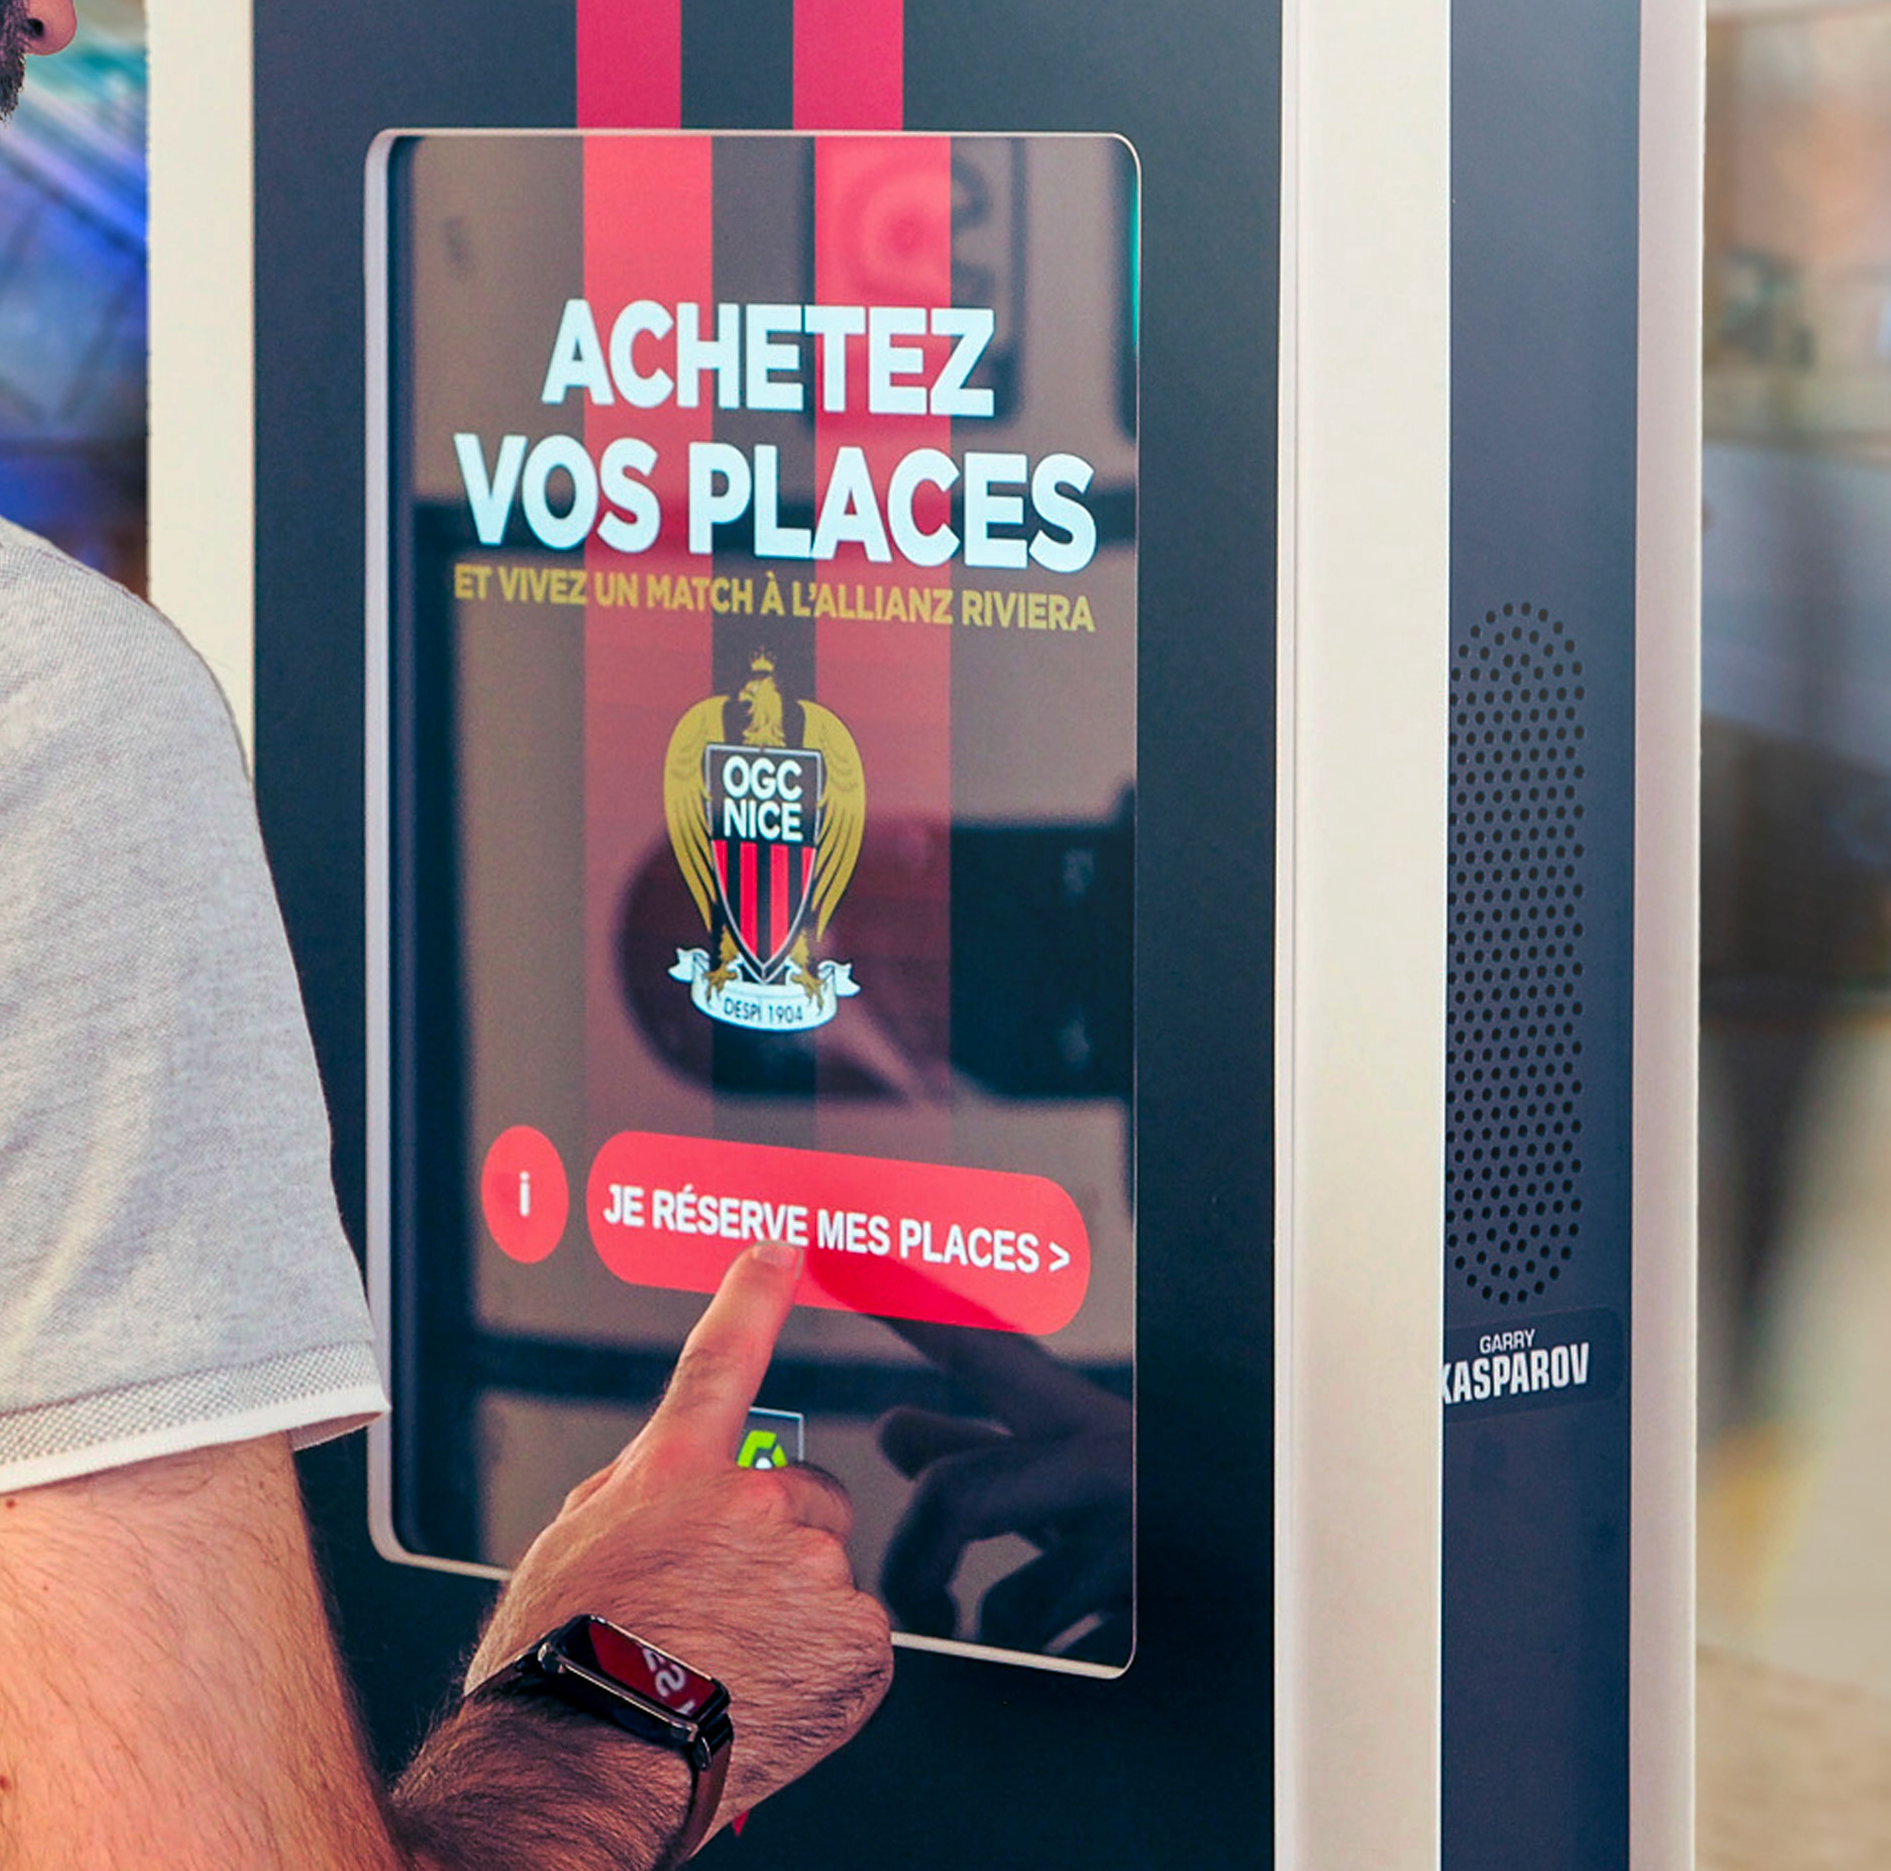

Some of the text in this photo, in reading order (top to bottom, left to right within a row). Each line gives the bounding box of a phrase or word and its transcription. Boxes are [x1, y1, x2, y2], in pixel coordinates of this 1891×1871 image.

[541, 298, 994, 417] ACHETEZ
[453, 433, 1097, 573] VOS PLACES
[454, 564, 1095, 632] ET VIVEZ UN MATCH À L'ALLIANZ RIVIERA
[723, 756, 803, 799] OGC
[723, 799, 804, 842] NICE
[604, 1185, 1040, 1273] JE RÉSERVE MES PLACES
[1479, 1329, 1535, 1354] GARRY
